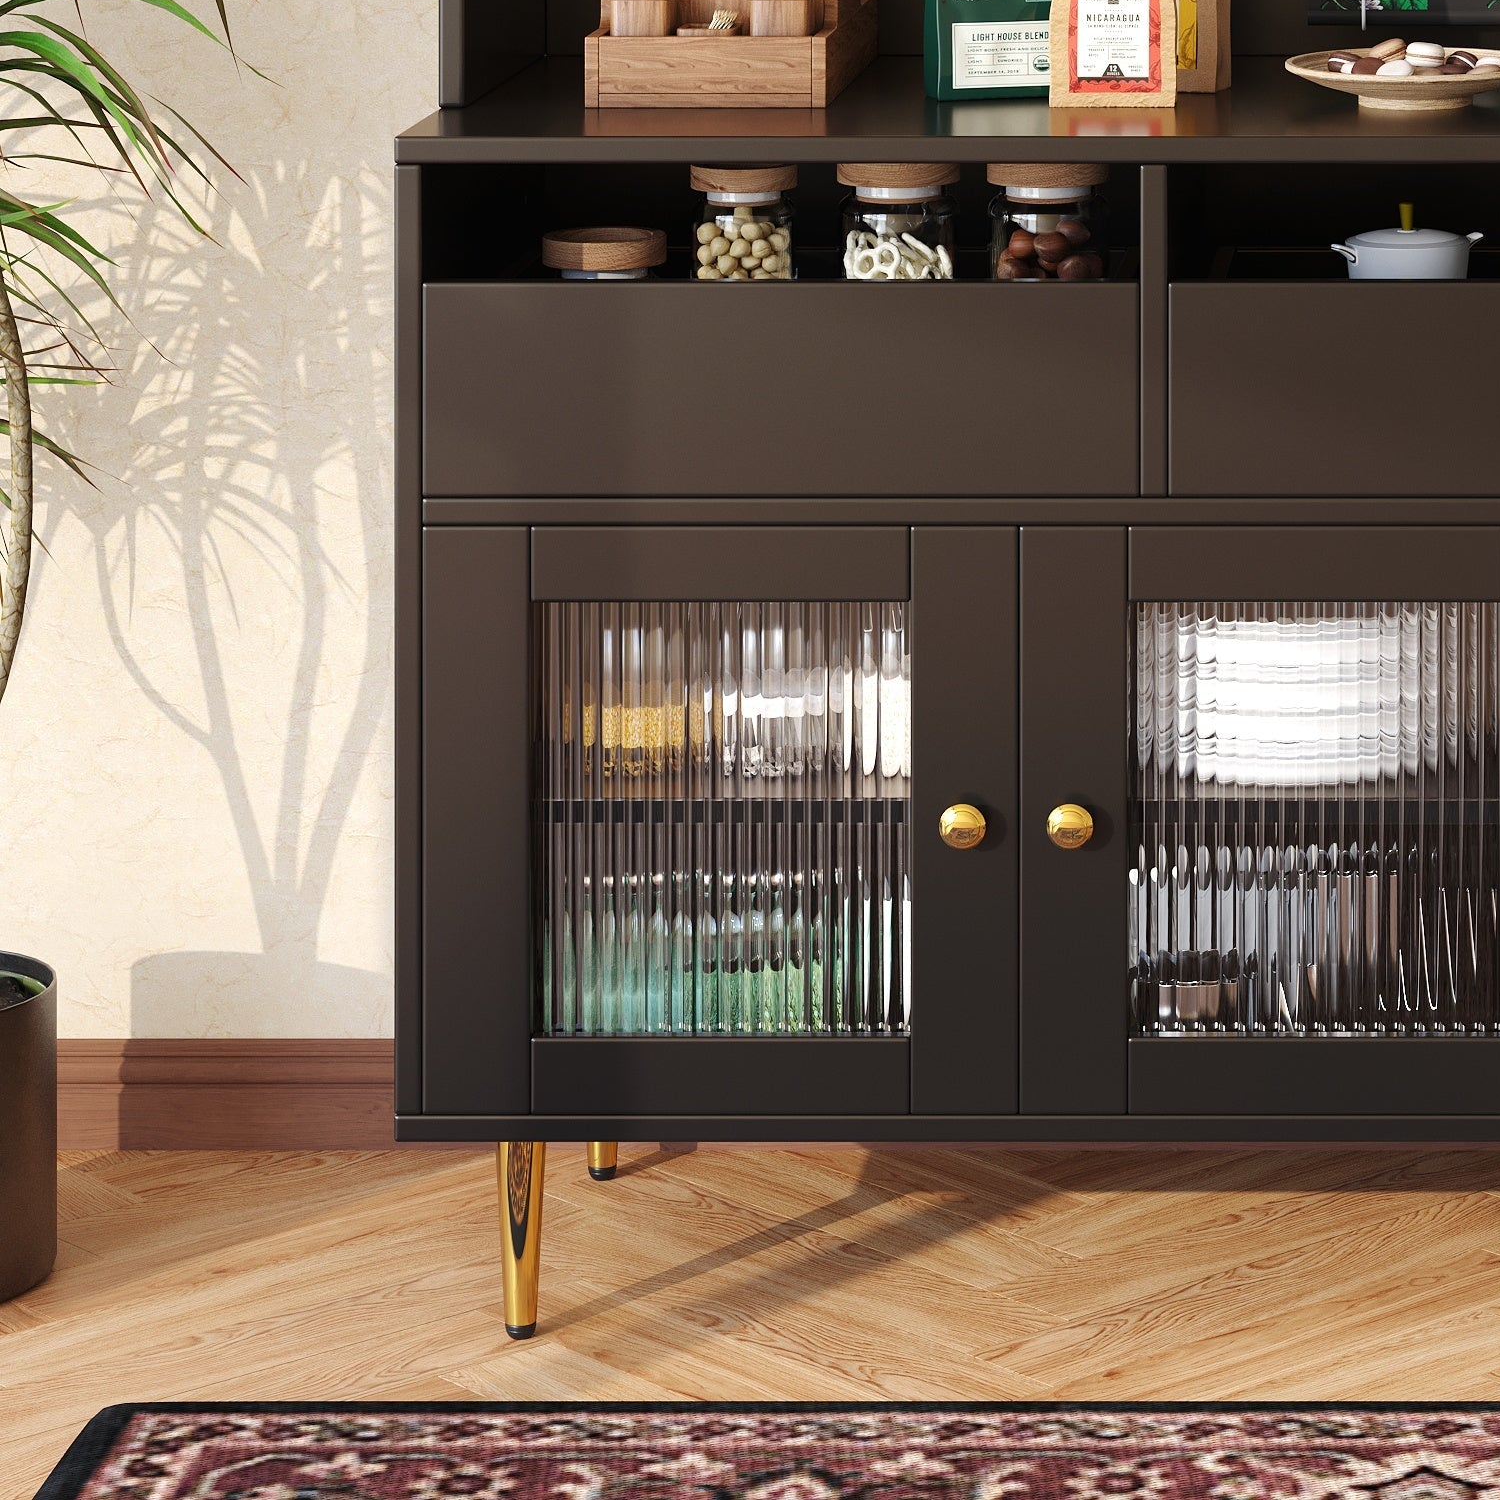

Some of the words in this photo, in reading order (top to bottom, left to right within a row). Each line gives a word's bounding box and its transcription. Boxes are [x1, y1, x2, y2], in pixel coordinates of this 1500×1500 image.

[1086, 13, 1140, 22] NICARAGUA
[972, 33, 994, 41] LIGHT
[997, 32, 1021, 40] HOUSE
[1024, 31, 1049, 40] BLEND
